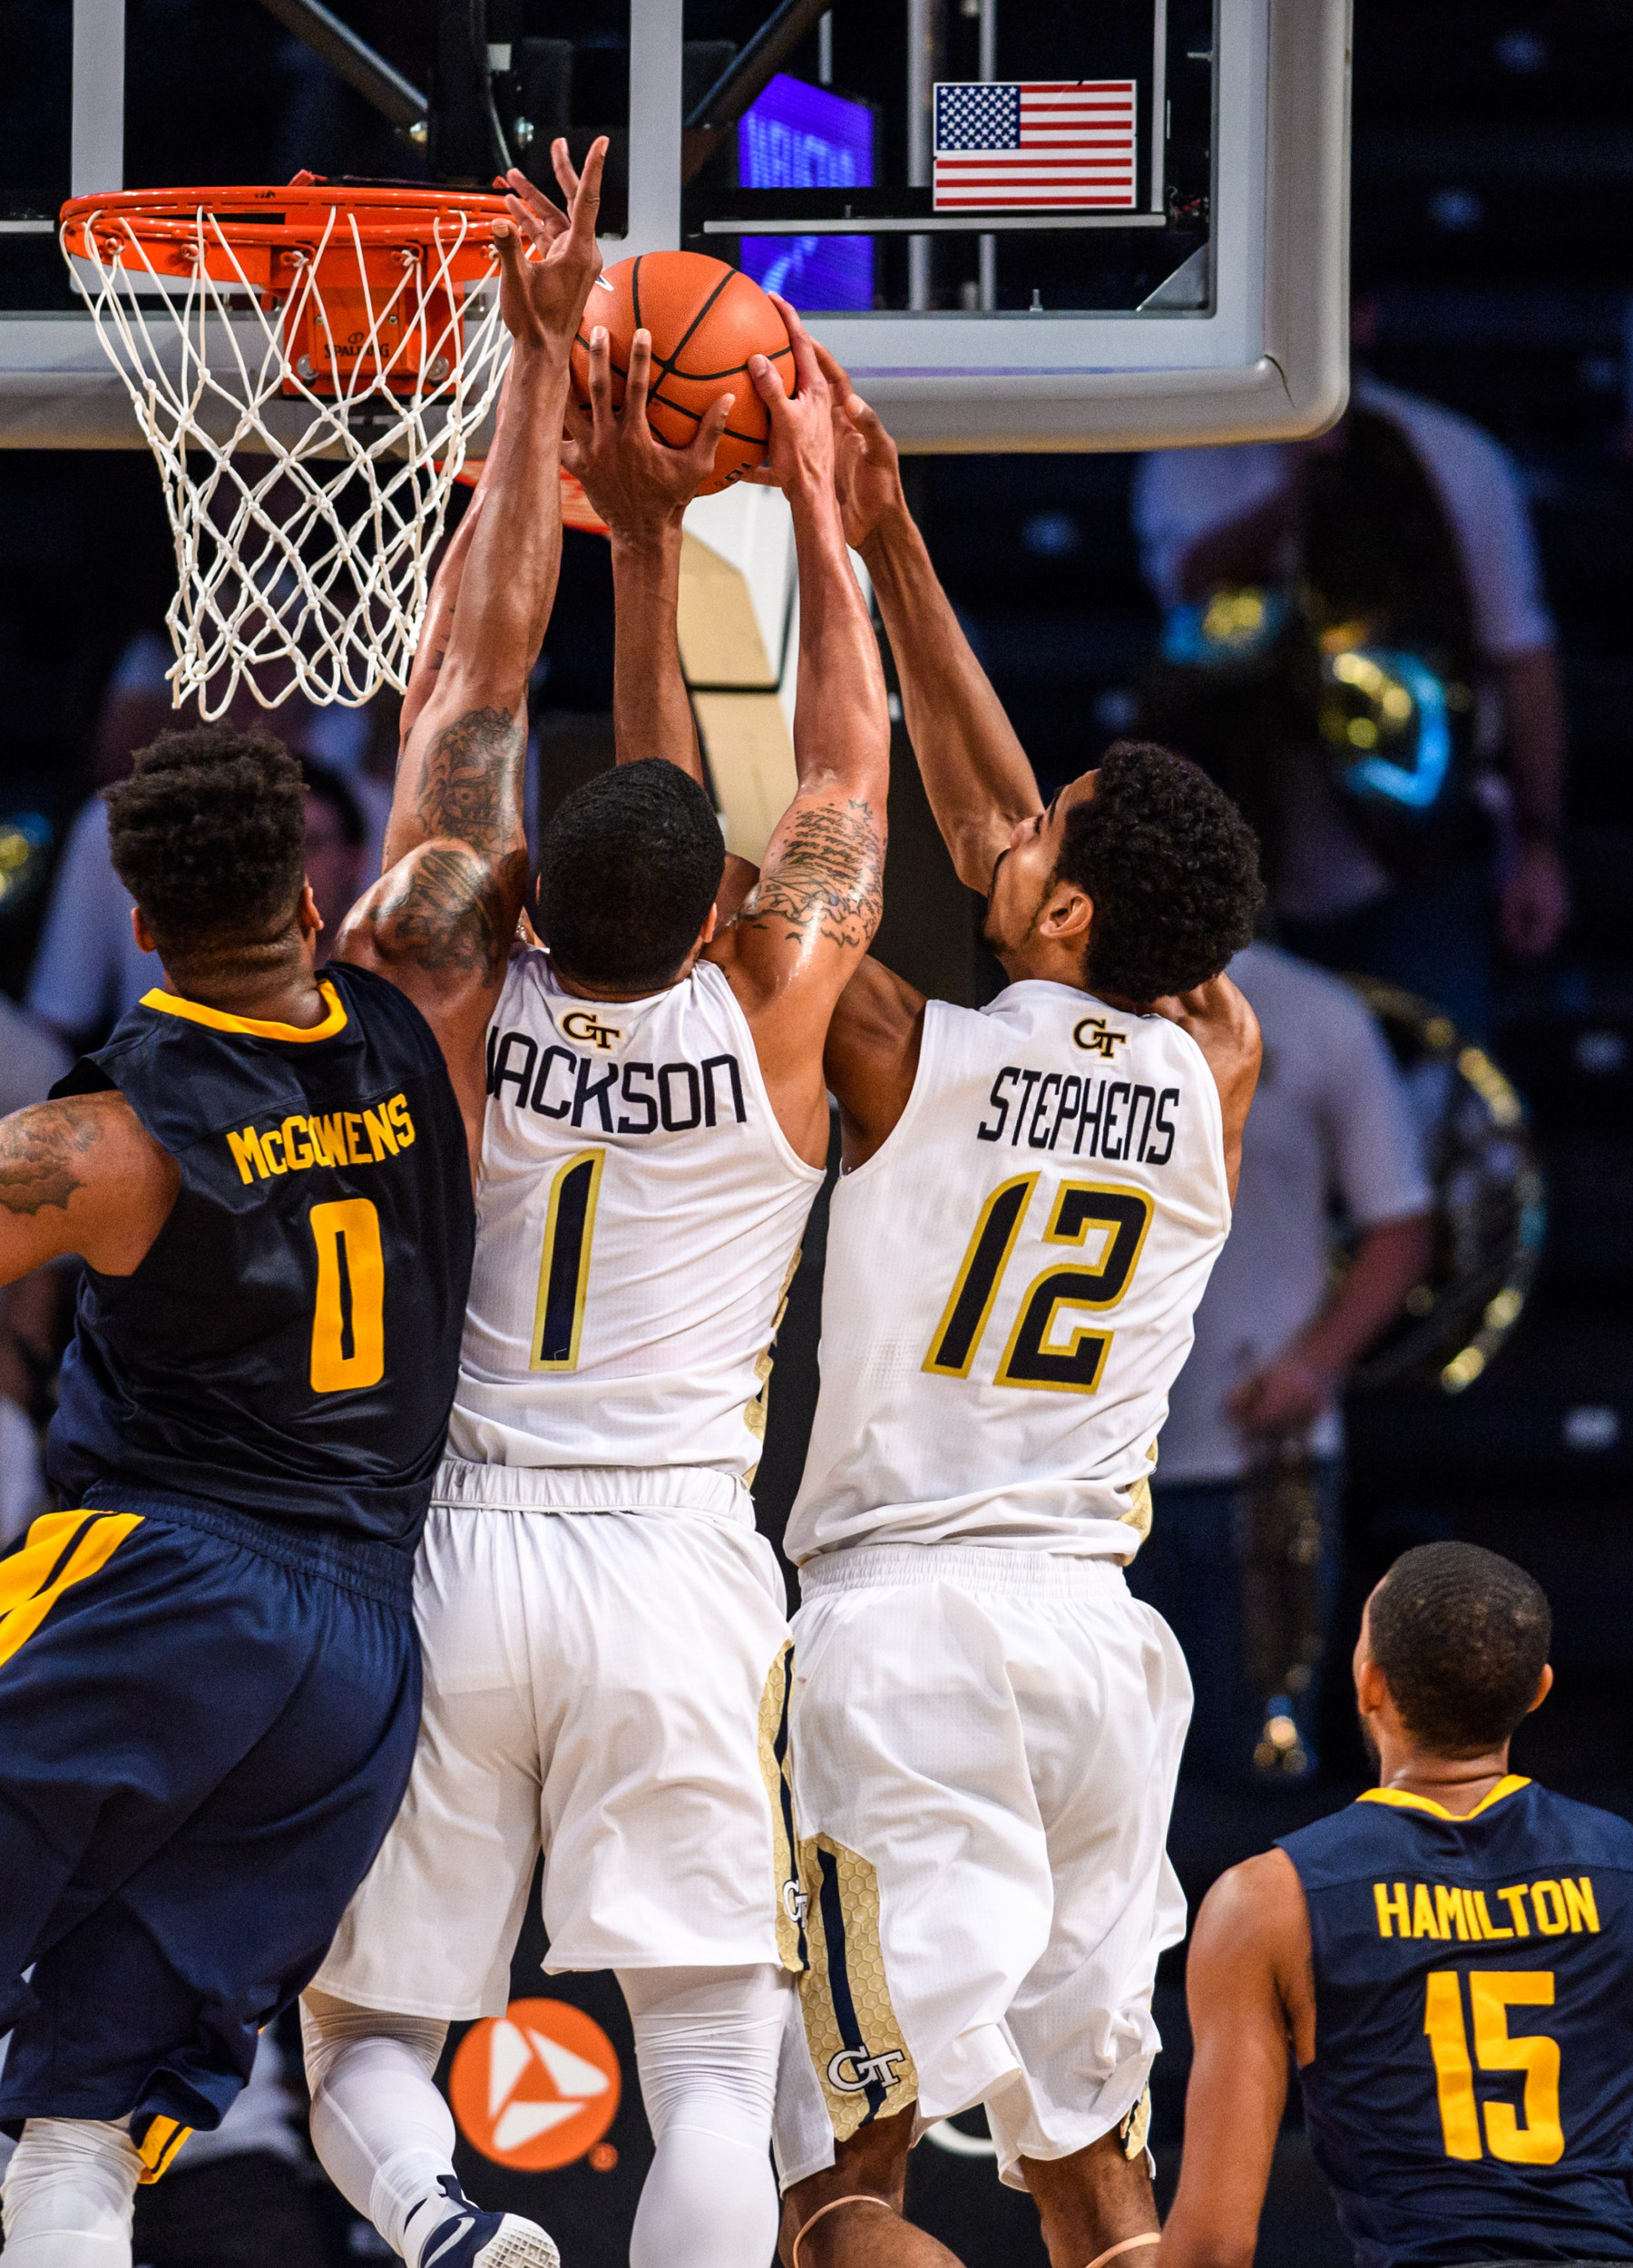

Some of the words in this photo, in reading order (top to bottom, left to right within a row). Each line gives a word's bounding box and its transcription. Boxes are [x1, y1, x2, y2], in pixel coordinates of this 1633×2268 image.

[486, 1025, 747, 1134] JACKSON
[977, 1066, 1179, 1166] STEPHENS
[309, 1198, 385, 1393] 0
[529, 1148, 606, 1371] 1
[921, 1170, 1155, 1394] 12
[1373, 1877, 1600, 1941] HAMILTON
[1423, 1970, 1565, 2165] 15
